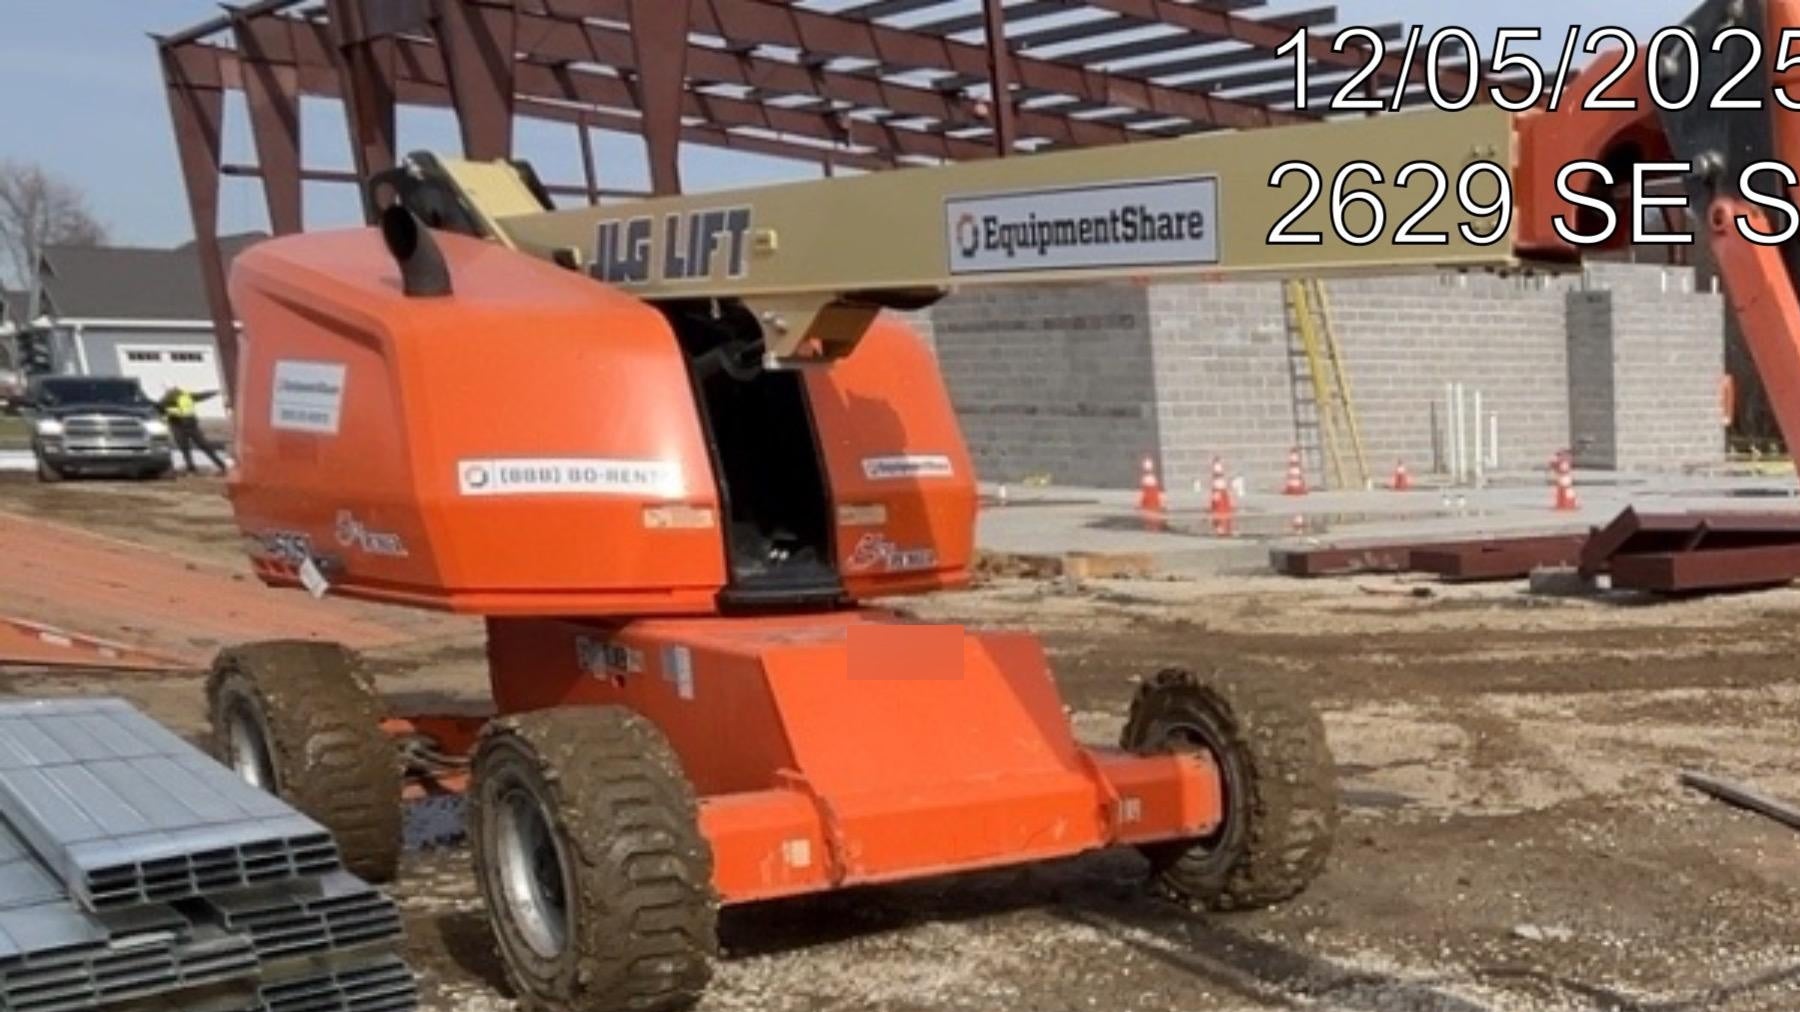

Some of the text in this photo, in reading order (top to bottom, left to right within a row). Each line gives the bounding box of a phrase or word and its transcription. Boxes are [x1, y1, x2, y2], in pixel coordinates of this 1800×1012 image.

[587, 203, 752, 285] JLG LIFT
[981, 204, 1205, 258] EquipmentShare
